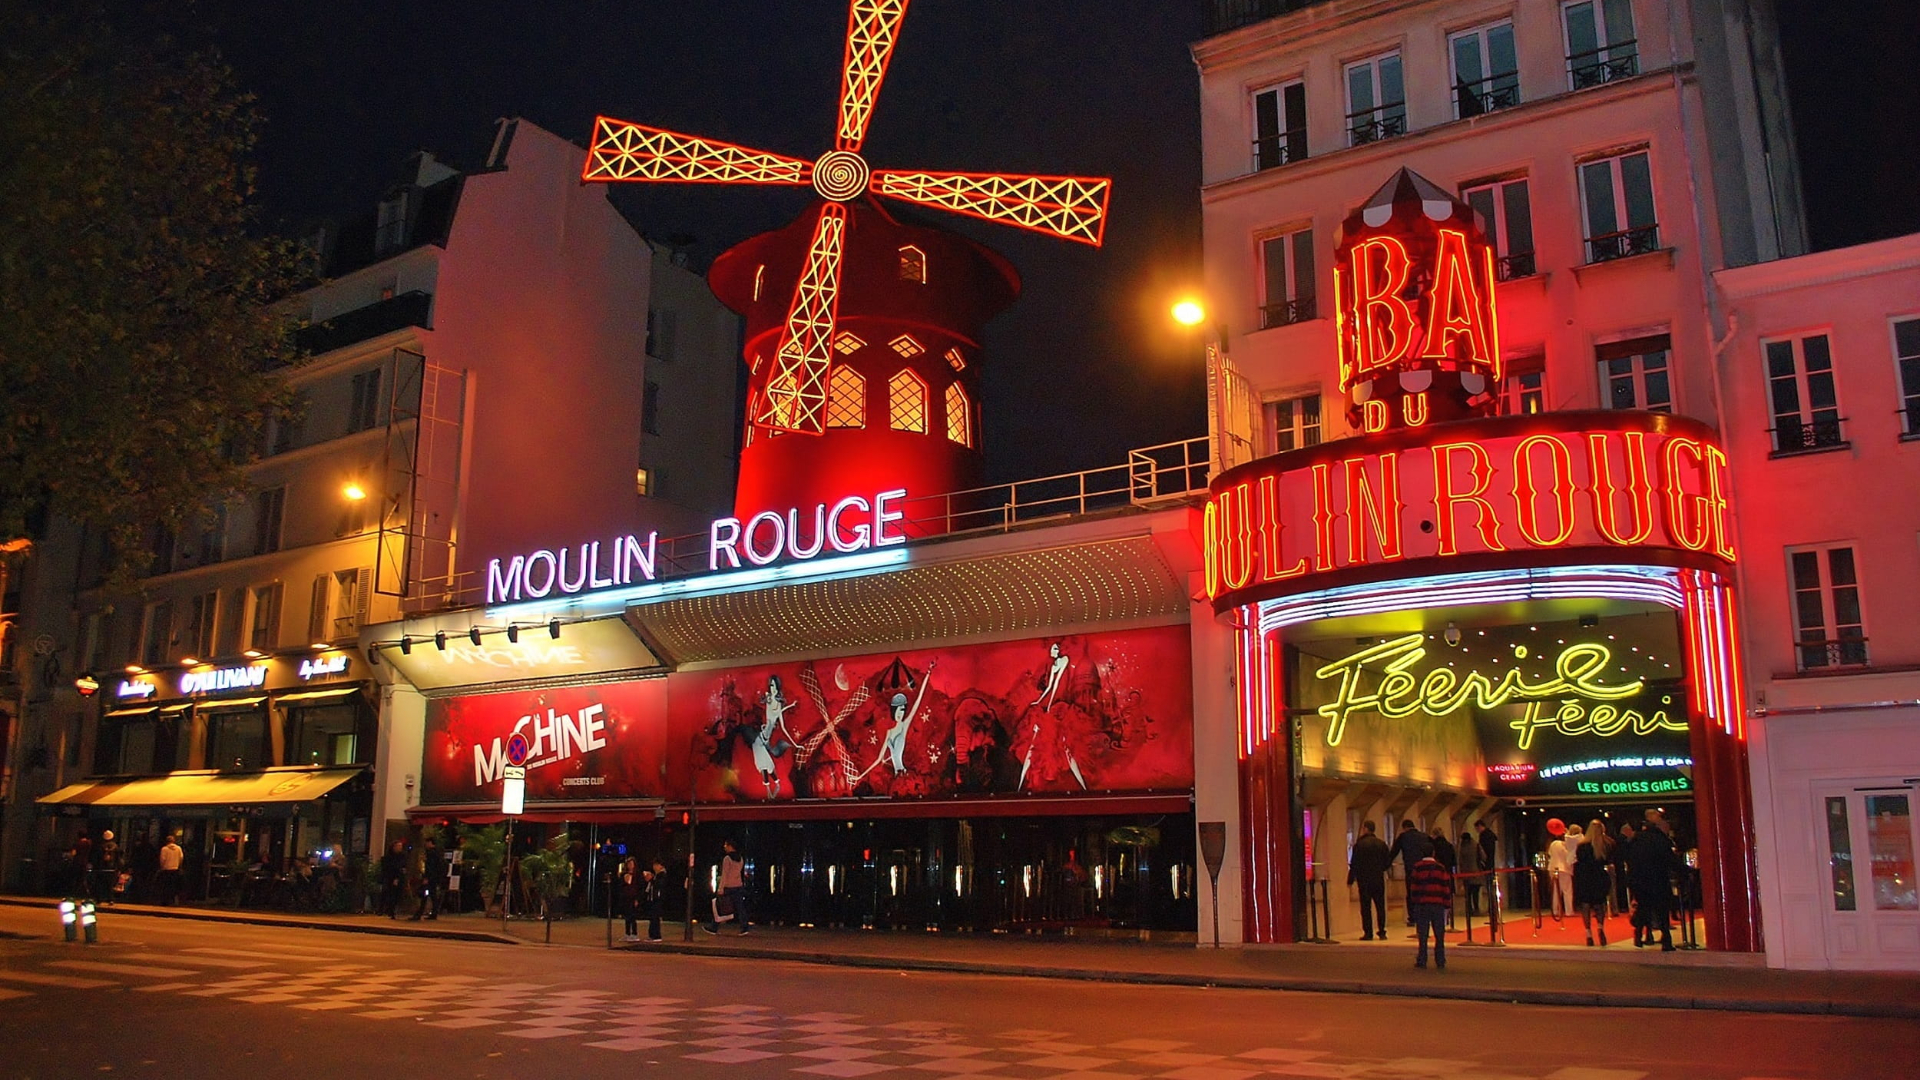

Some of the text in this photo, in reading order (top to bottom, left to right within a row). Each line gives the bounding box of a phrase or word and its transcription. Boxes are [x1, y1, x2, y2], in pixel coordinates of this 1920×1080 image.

[1363, 393, 1429, 433] DU
[1431, 431, 1736, 562] ROUGE
[486, 488, 907, 604] MOULIN ROUGE
[1577, 777, 1688, 794] LES DORISS GIRLS
